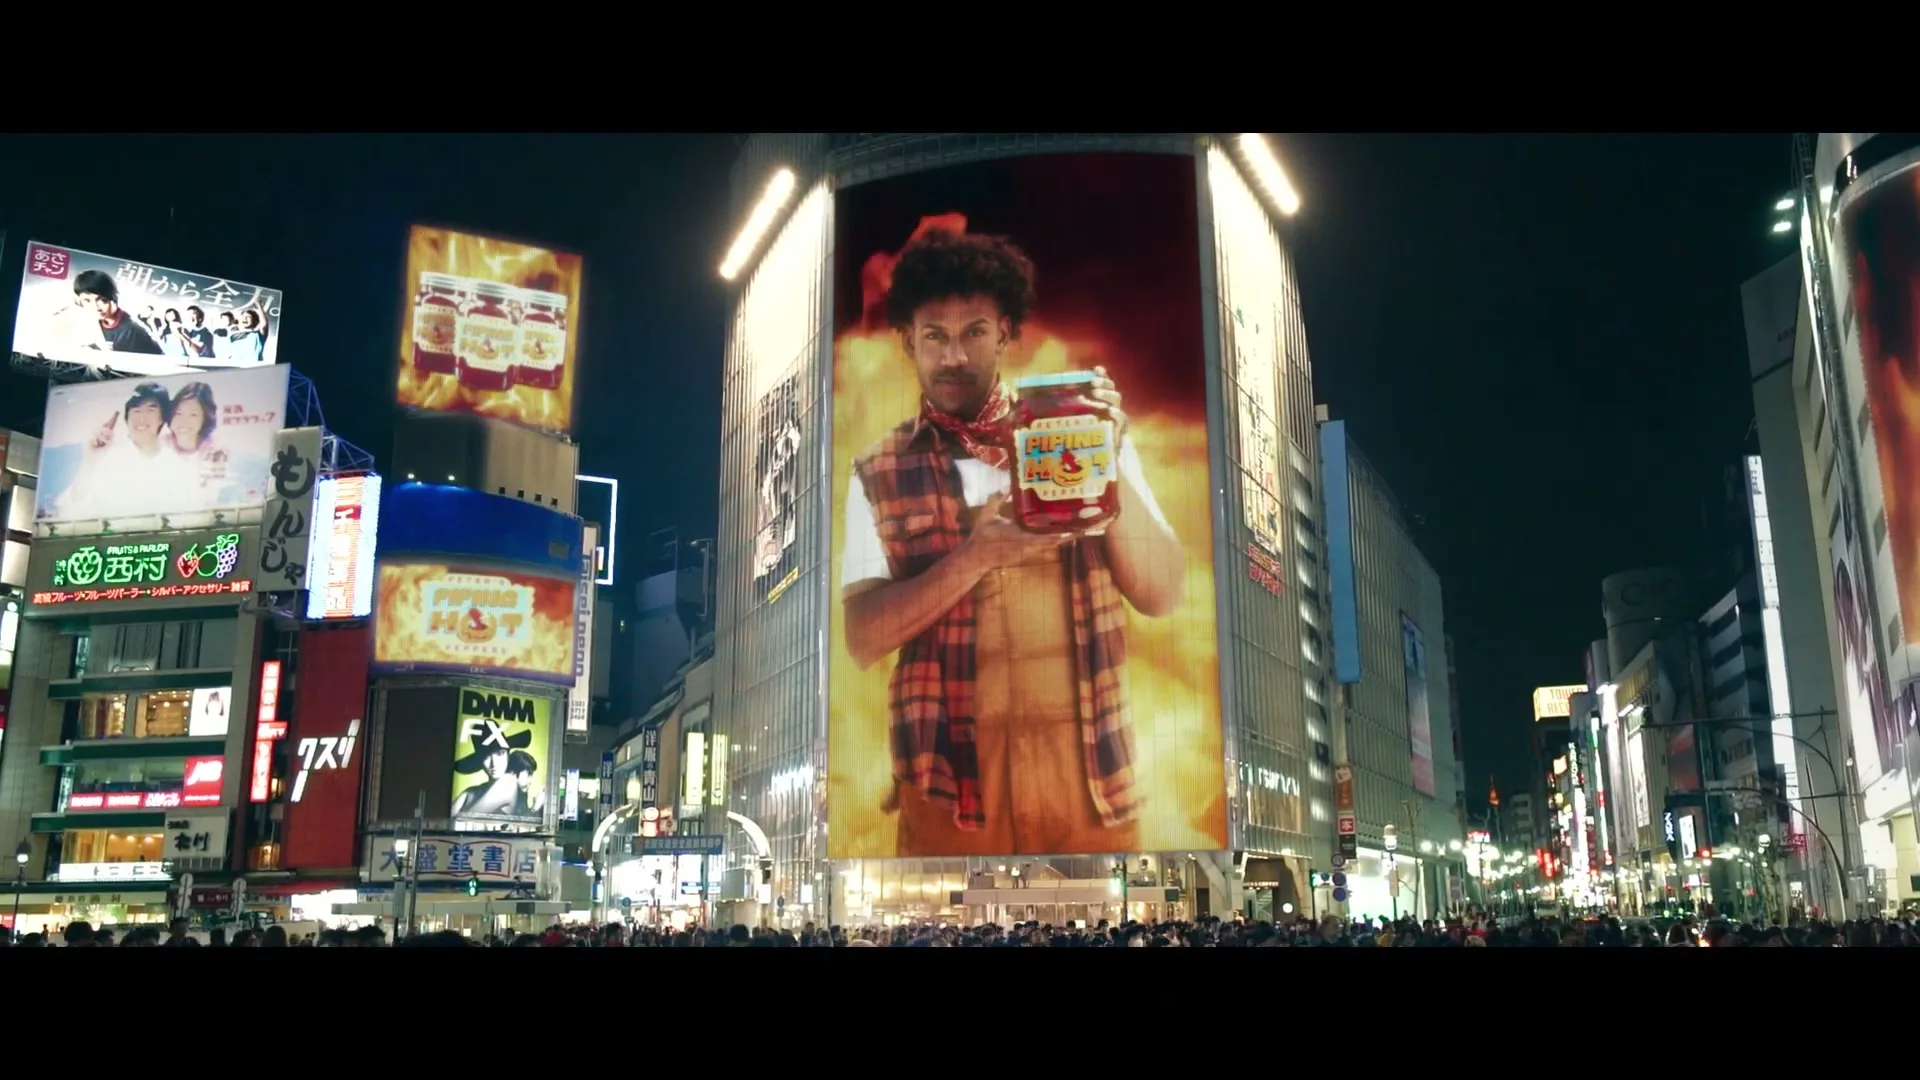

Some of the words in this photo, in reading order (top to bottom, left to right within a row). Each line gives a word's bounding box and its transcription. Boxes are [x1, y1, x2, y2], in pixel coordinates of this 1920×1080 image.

[33, 261, 64, 275] チャン
[34, 249, 67, 264] あさ
[116, 262, 280, 317] 朝から全力。
[1024, 450, 1110, 487] HOT
[258, 444, 316, 586] もんじゃ
[104, 554, 167, 582] 西村
[433, 588, 519, 608] PIPING
[428, 609, 524, 643] HOT
[462, 689, 536, 725] DMM
[459, 718, 510, 749] FX
[1664, 812, 1675, 842] ZARA
[380, 844, 538, 874] 大盛堂書店
